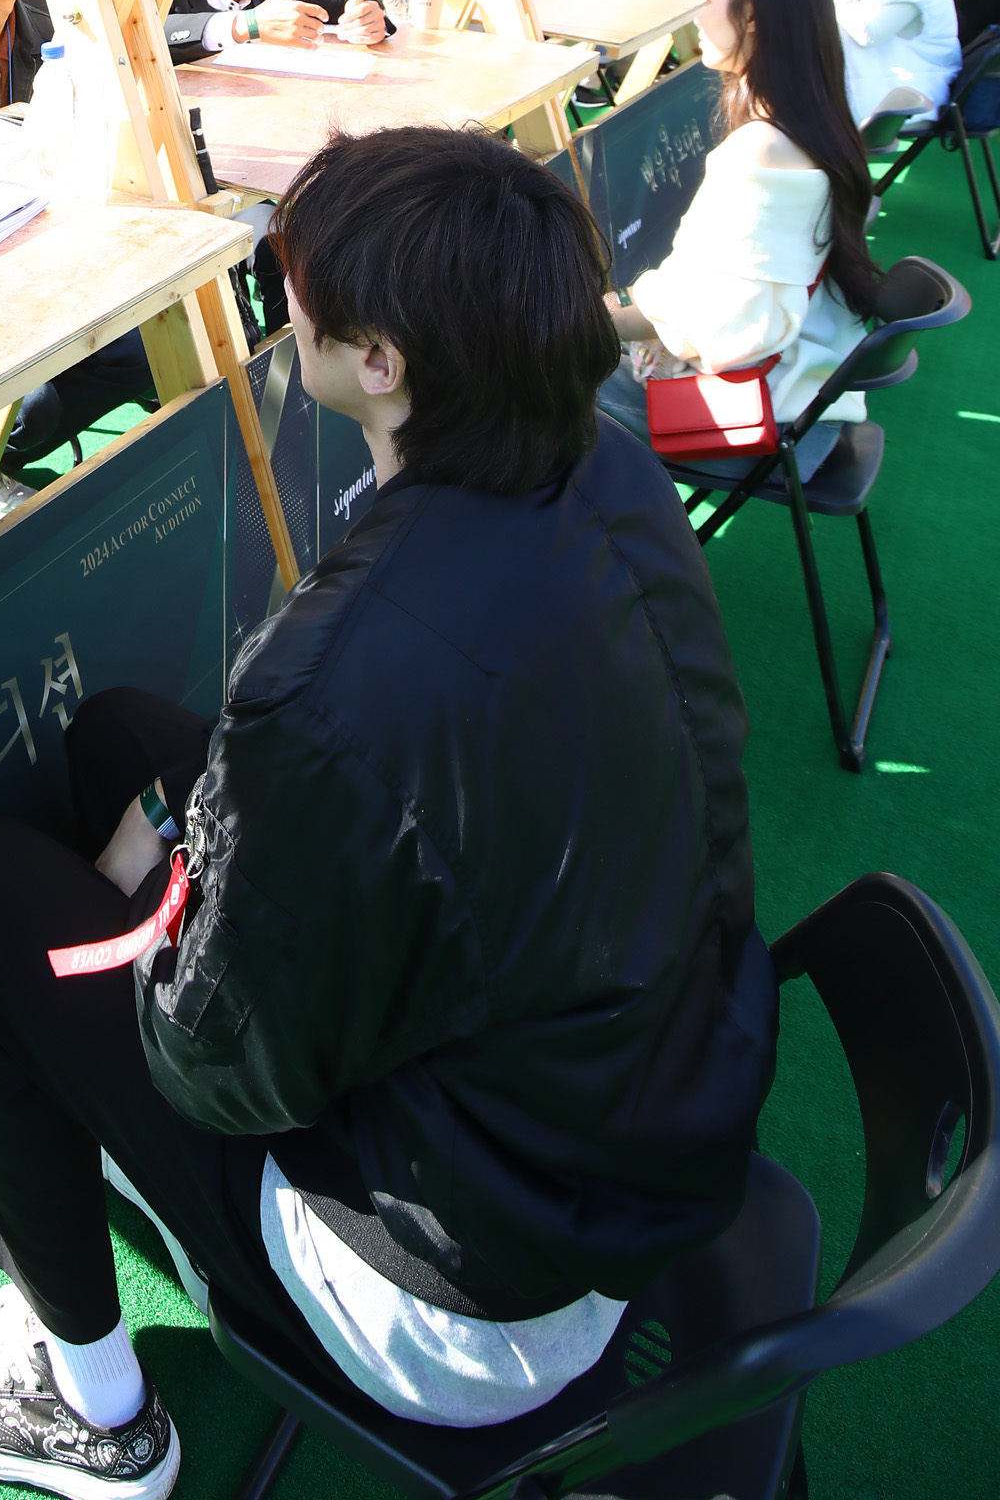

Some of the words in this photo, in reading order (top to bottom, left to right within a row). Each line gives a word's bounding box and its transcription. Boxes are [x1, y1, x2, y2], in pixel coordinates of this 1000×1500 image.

[155, 495, 203, 544] AUDITION
[158, 899, 171, 929] ALL
[70, 945, 112, 969] COVER
[116, 920, 156, 960] AROUND
